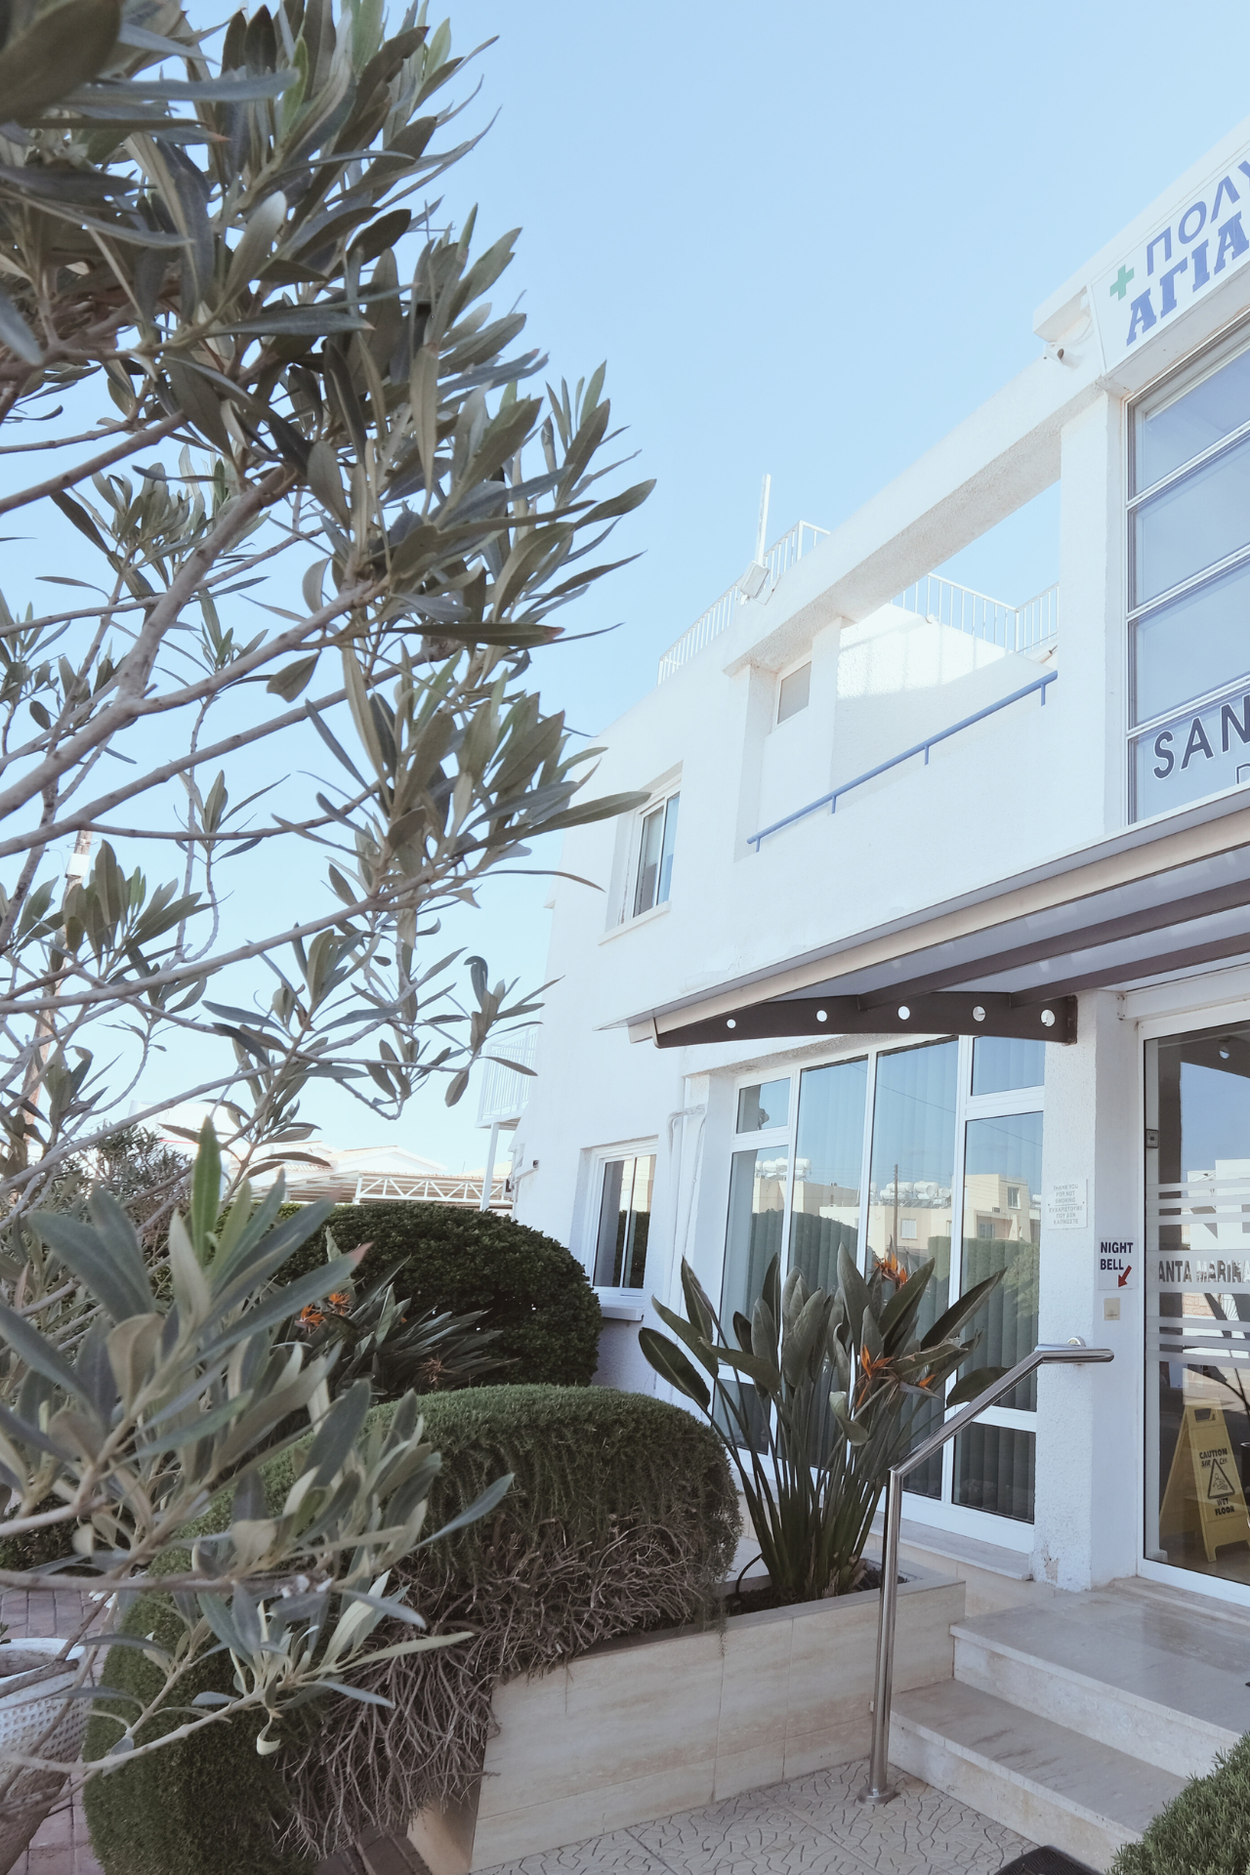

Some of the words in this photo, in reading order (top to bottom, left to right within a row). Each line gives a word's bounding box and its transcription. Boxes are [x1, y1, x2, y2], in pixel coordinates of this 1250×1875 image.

[1126, 212, 1250, 346] ΑΓΙΑ
[1100, 1241, 1133, 1254] NIGHT
[1100, 1258, 1124, 1270] BELL
[1158, 1260, 1192, 1283] ANTA
[1199, 1448, 1228, 1459] CAUTION
[1215, 1506, 1235, 1516] FLOOR
